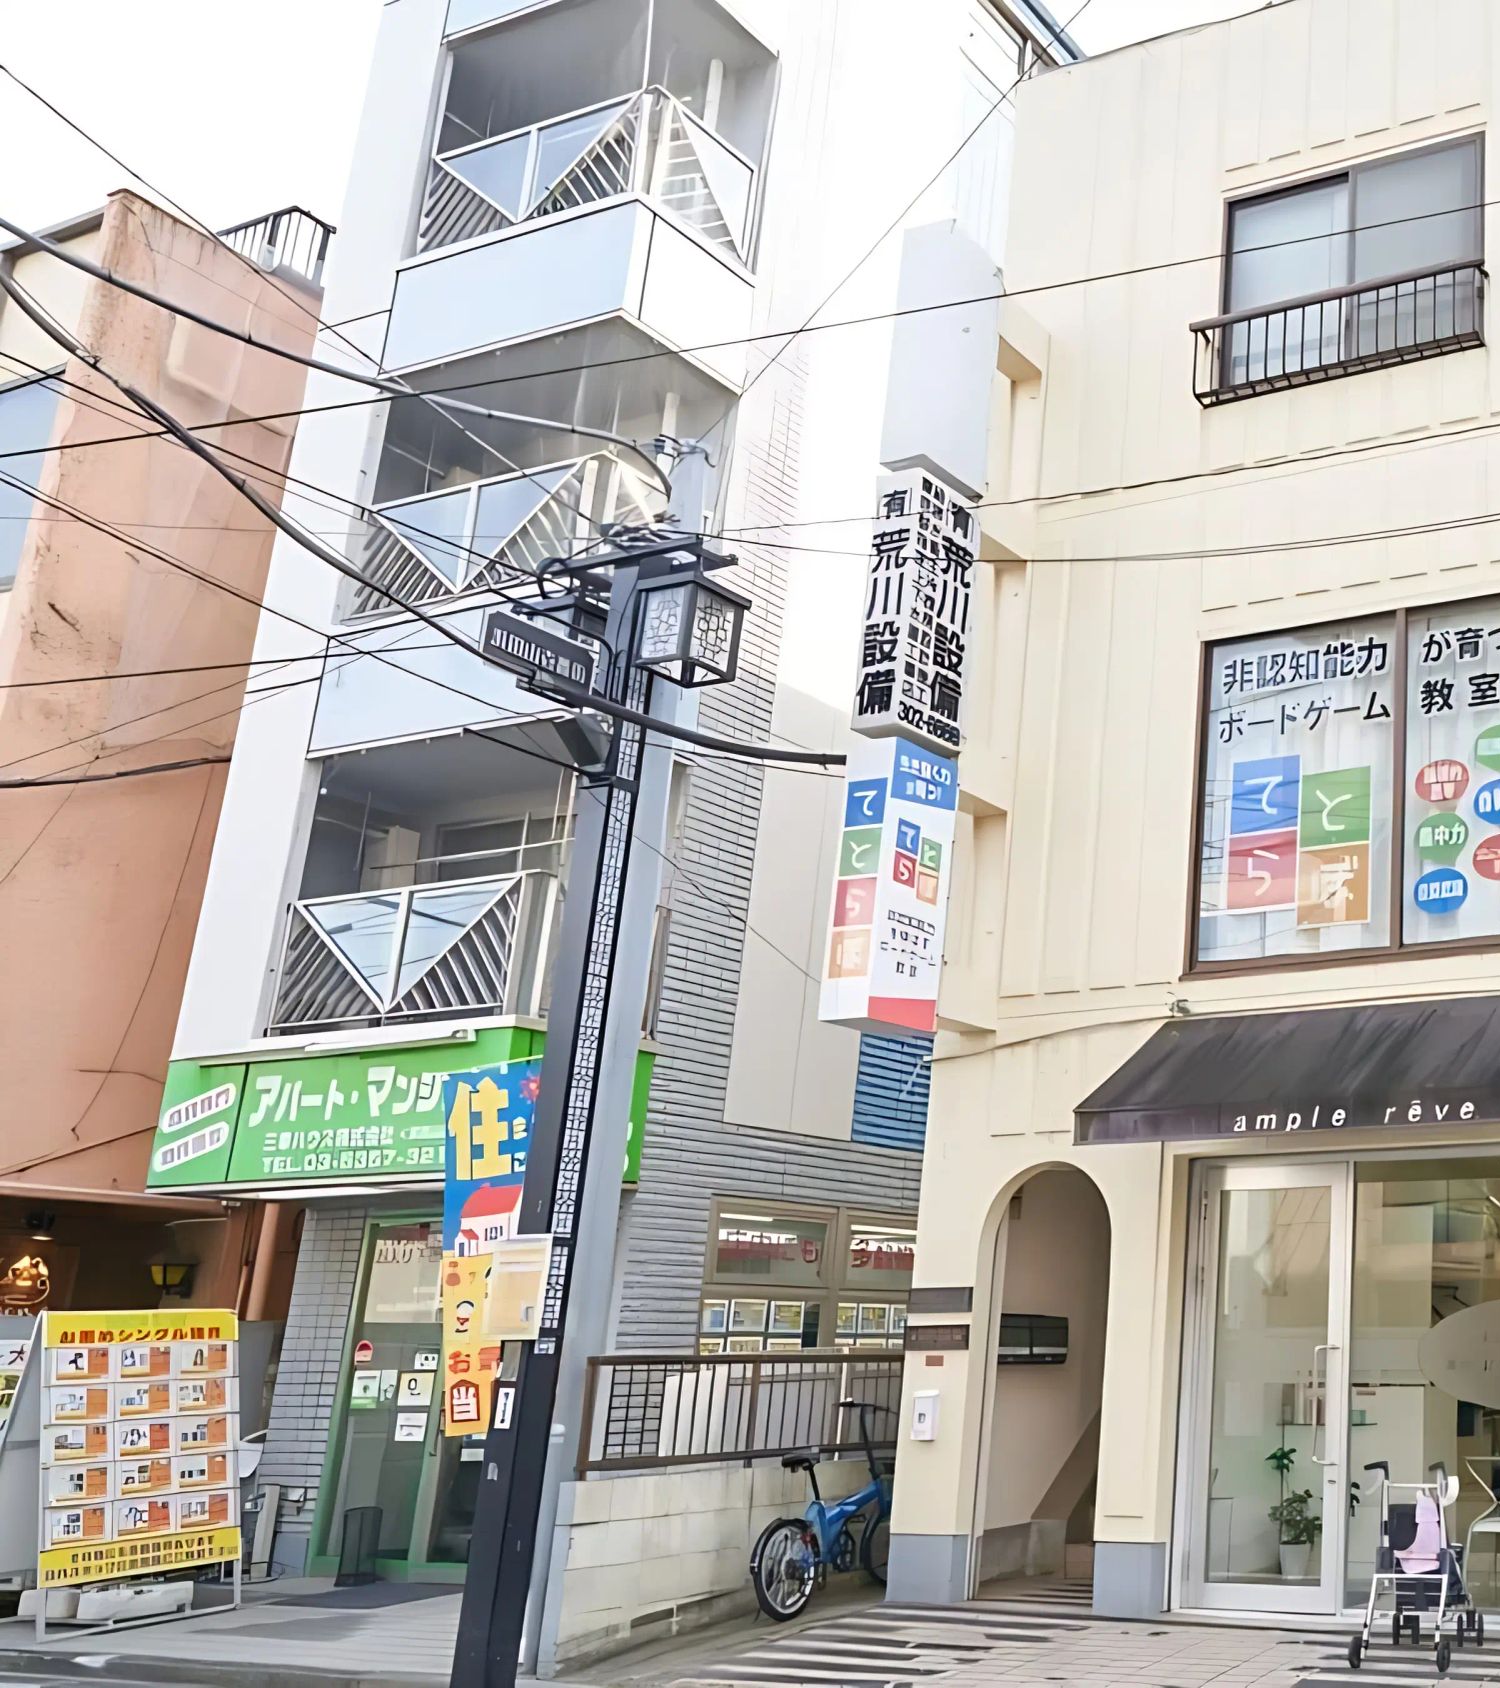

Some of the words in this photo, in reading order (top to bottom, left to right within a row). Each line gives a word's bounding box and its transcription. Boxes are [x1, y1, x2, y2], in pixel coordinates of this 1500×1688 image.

[1223, 637, 1389, 695] 非認知能力
[1219, 691, 1392, 744] ボードゲーム
[1420, 673, 1500, 715] 教室
[1233, 1105, 1347, 1132] ample
